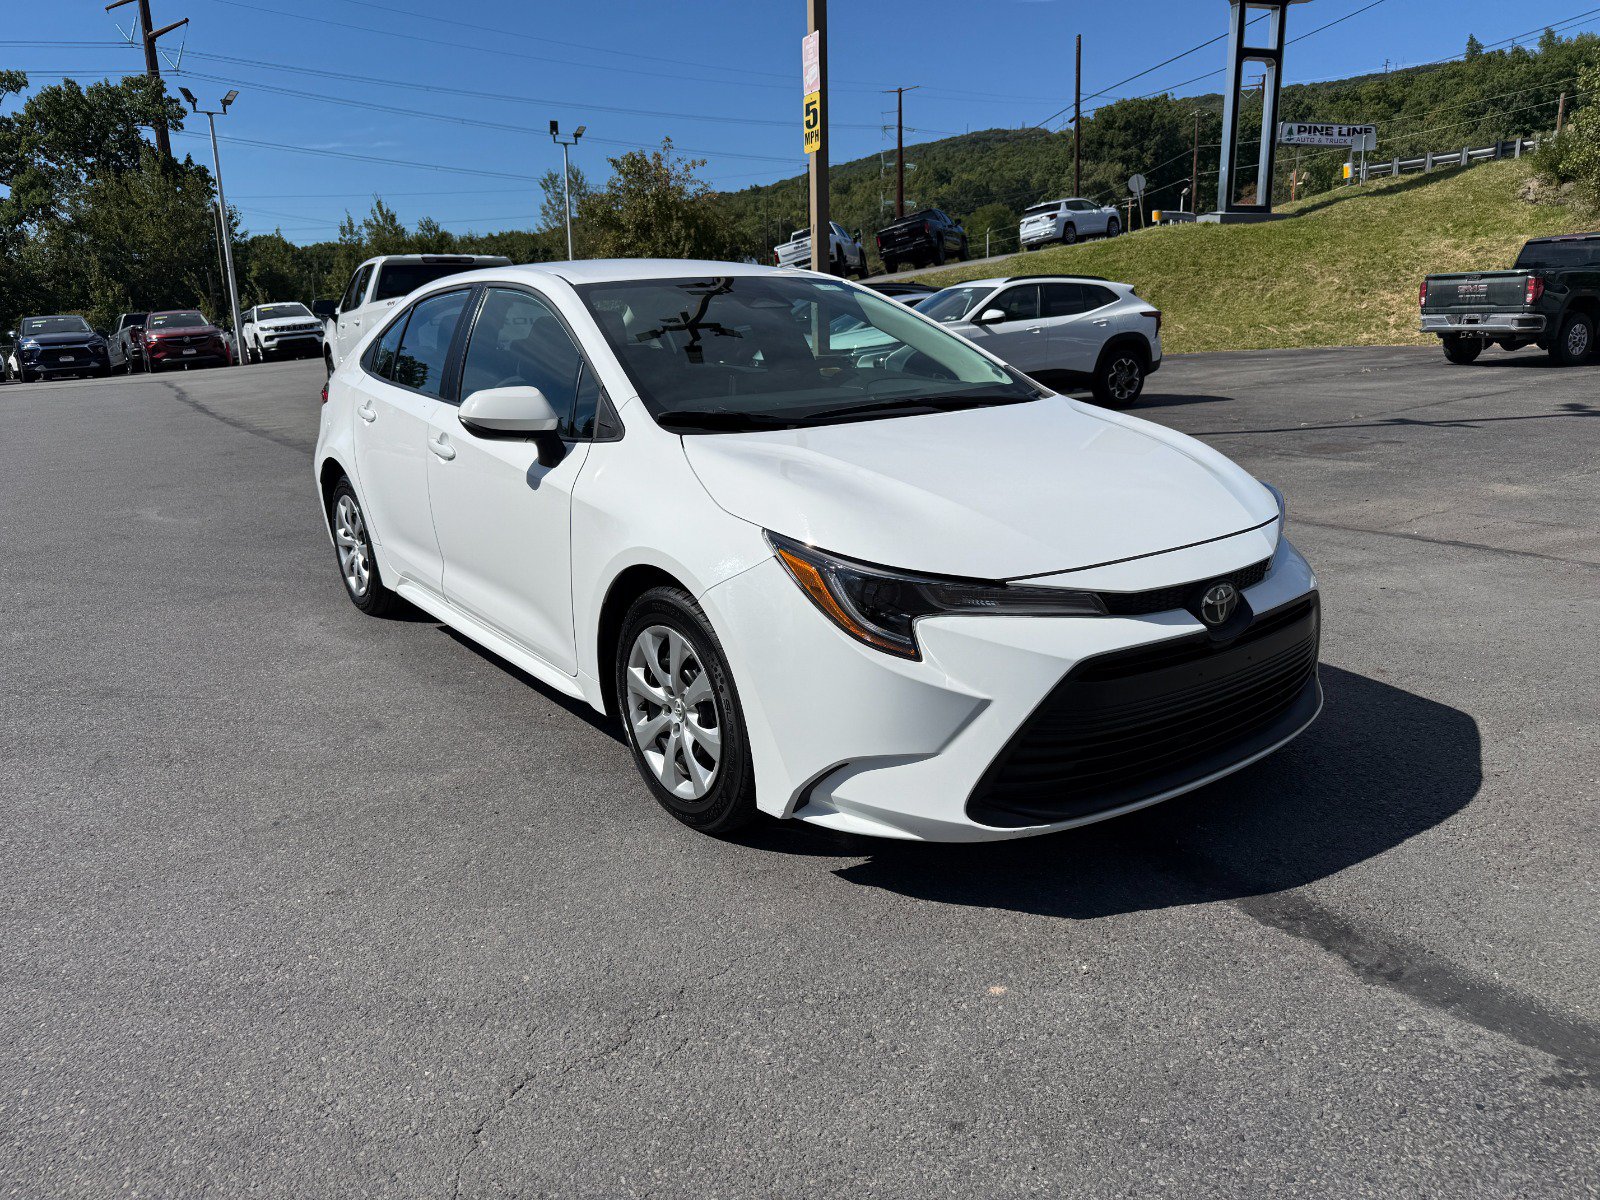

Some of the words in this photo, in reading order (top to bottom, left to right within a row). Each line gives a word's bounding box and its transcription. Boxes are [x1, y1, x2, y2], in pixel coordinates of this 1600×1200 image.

[805, 100, 818, 130] 5
[804, 129, 819, 146] MPH
[1297, 125, 1334, 137] PINE
